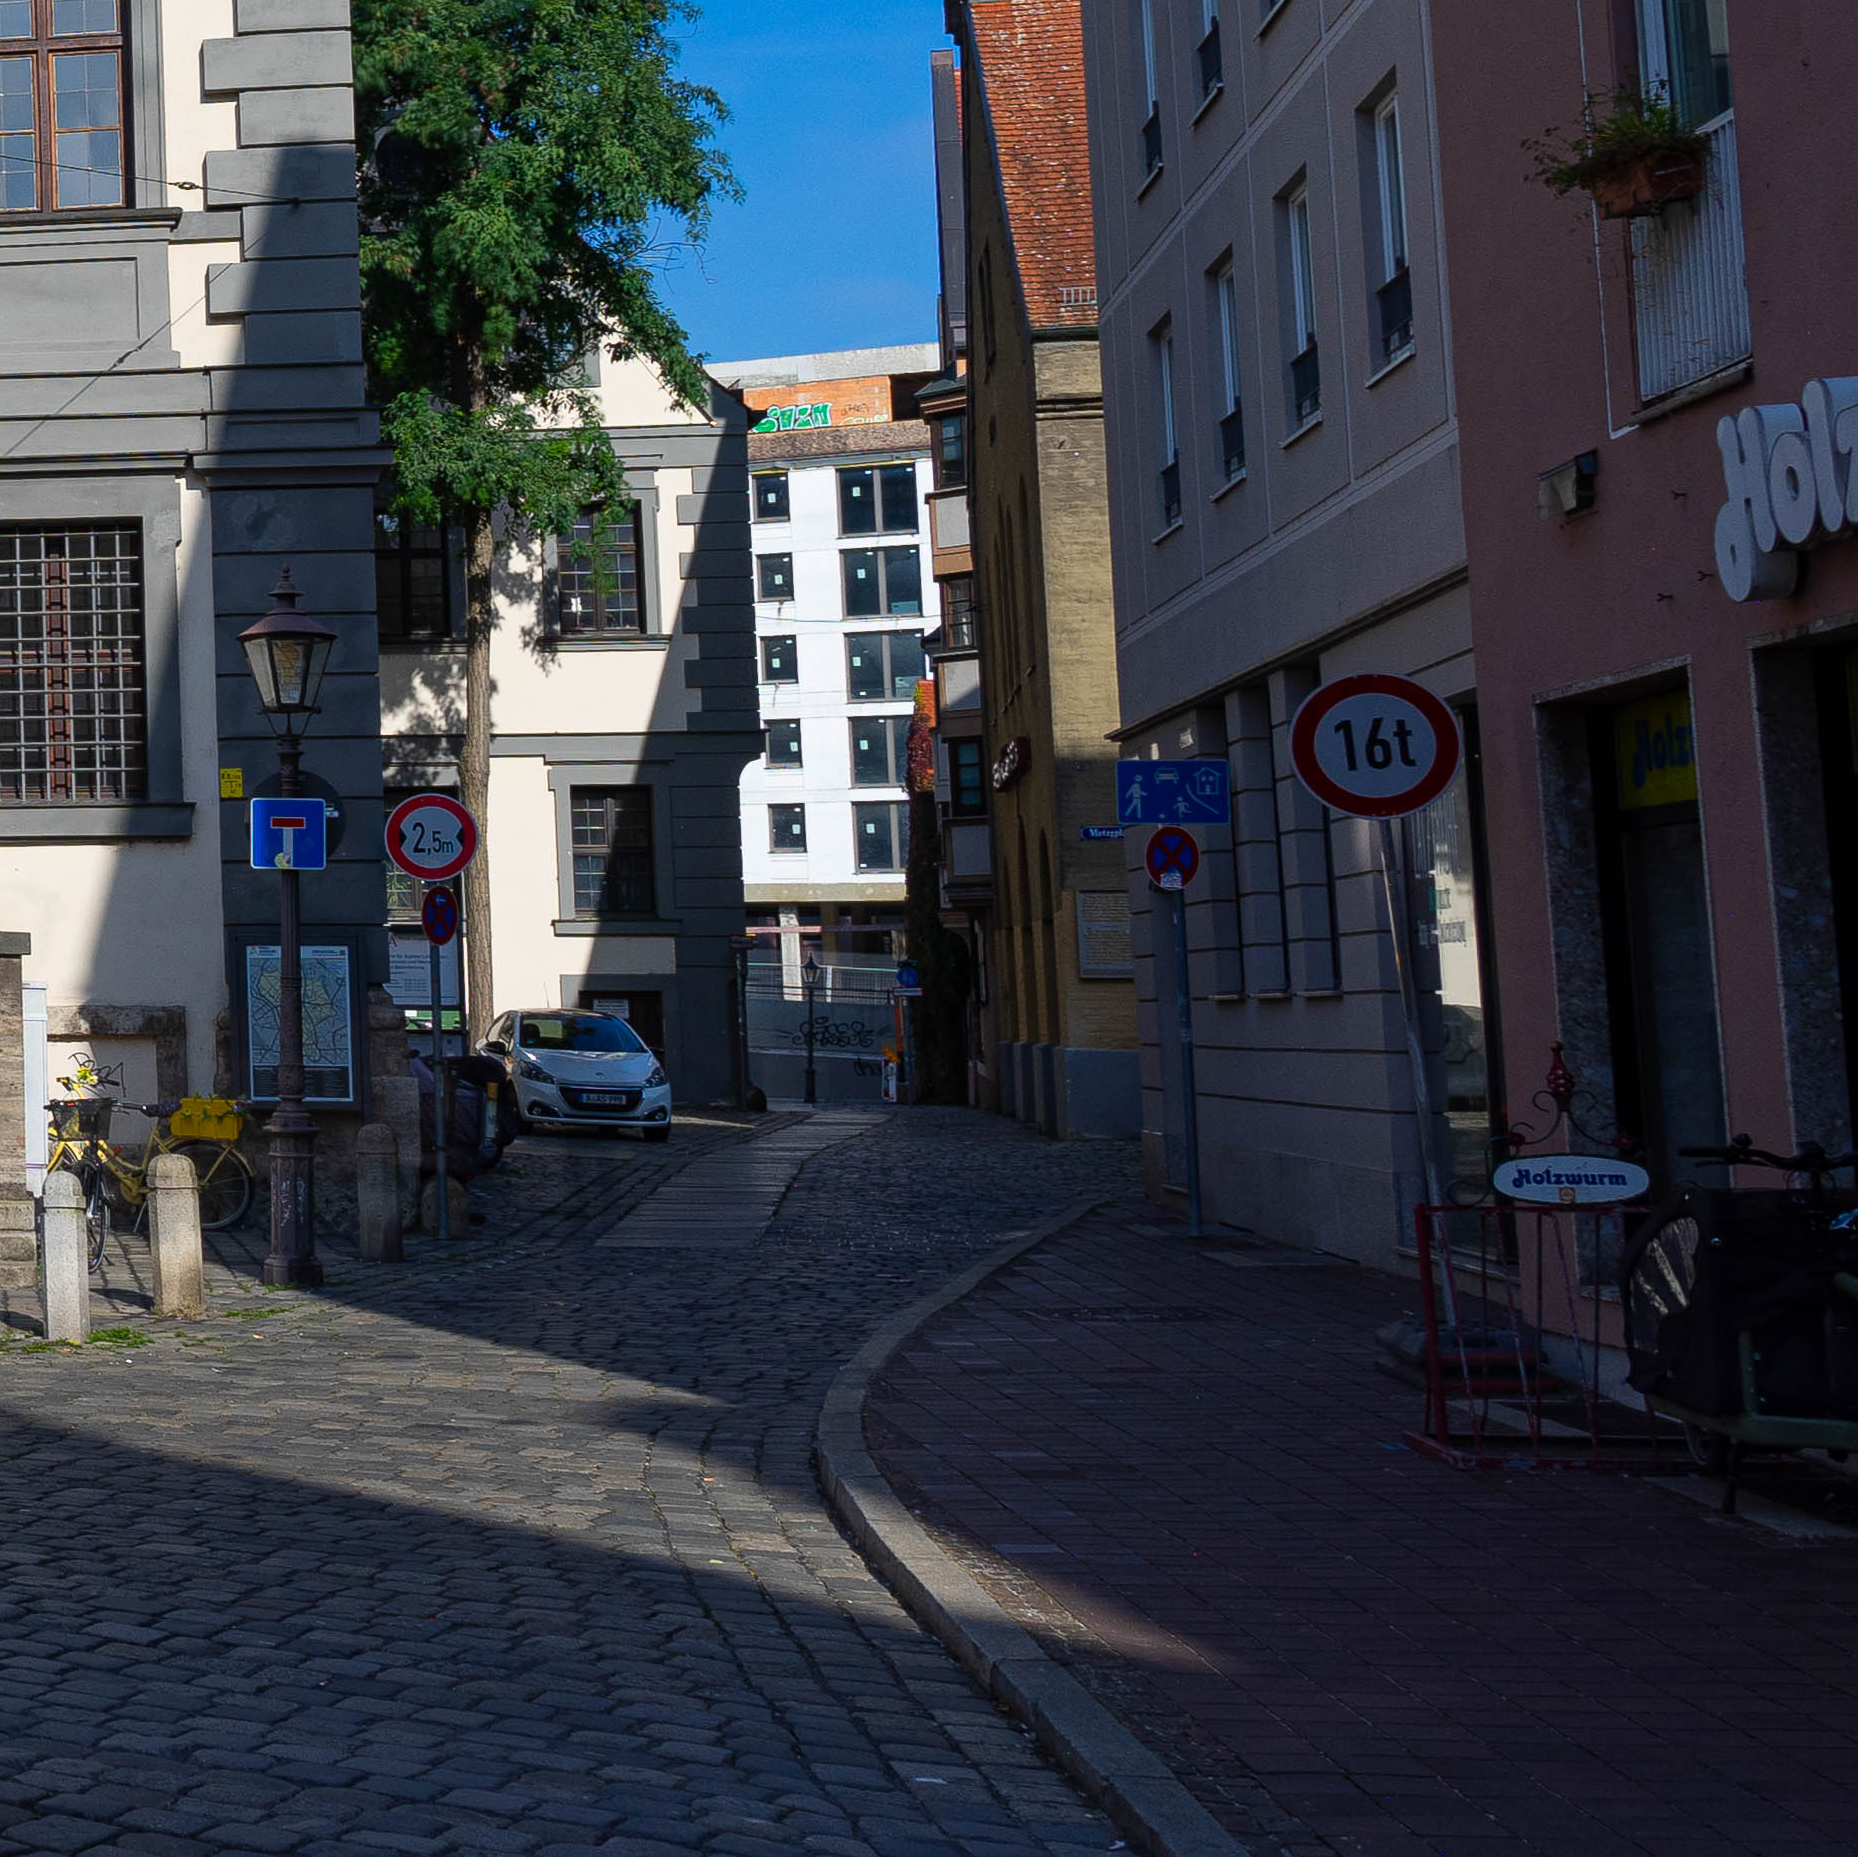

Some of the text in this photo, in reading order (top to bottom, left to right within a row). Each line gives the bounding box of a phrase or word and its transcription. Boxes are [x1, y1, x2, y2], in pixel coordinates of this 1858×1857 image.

[1334, 717, 1419, 772] 16t
[411, 821, 455, 856] 2,5m
[1512, 1168, 1628, 1189] Holzwurm
